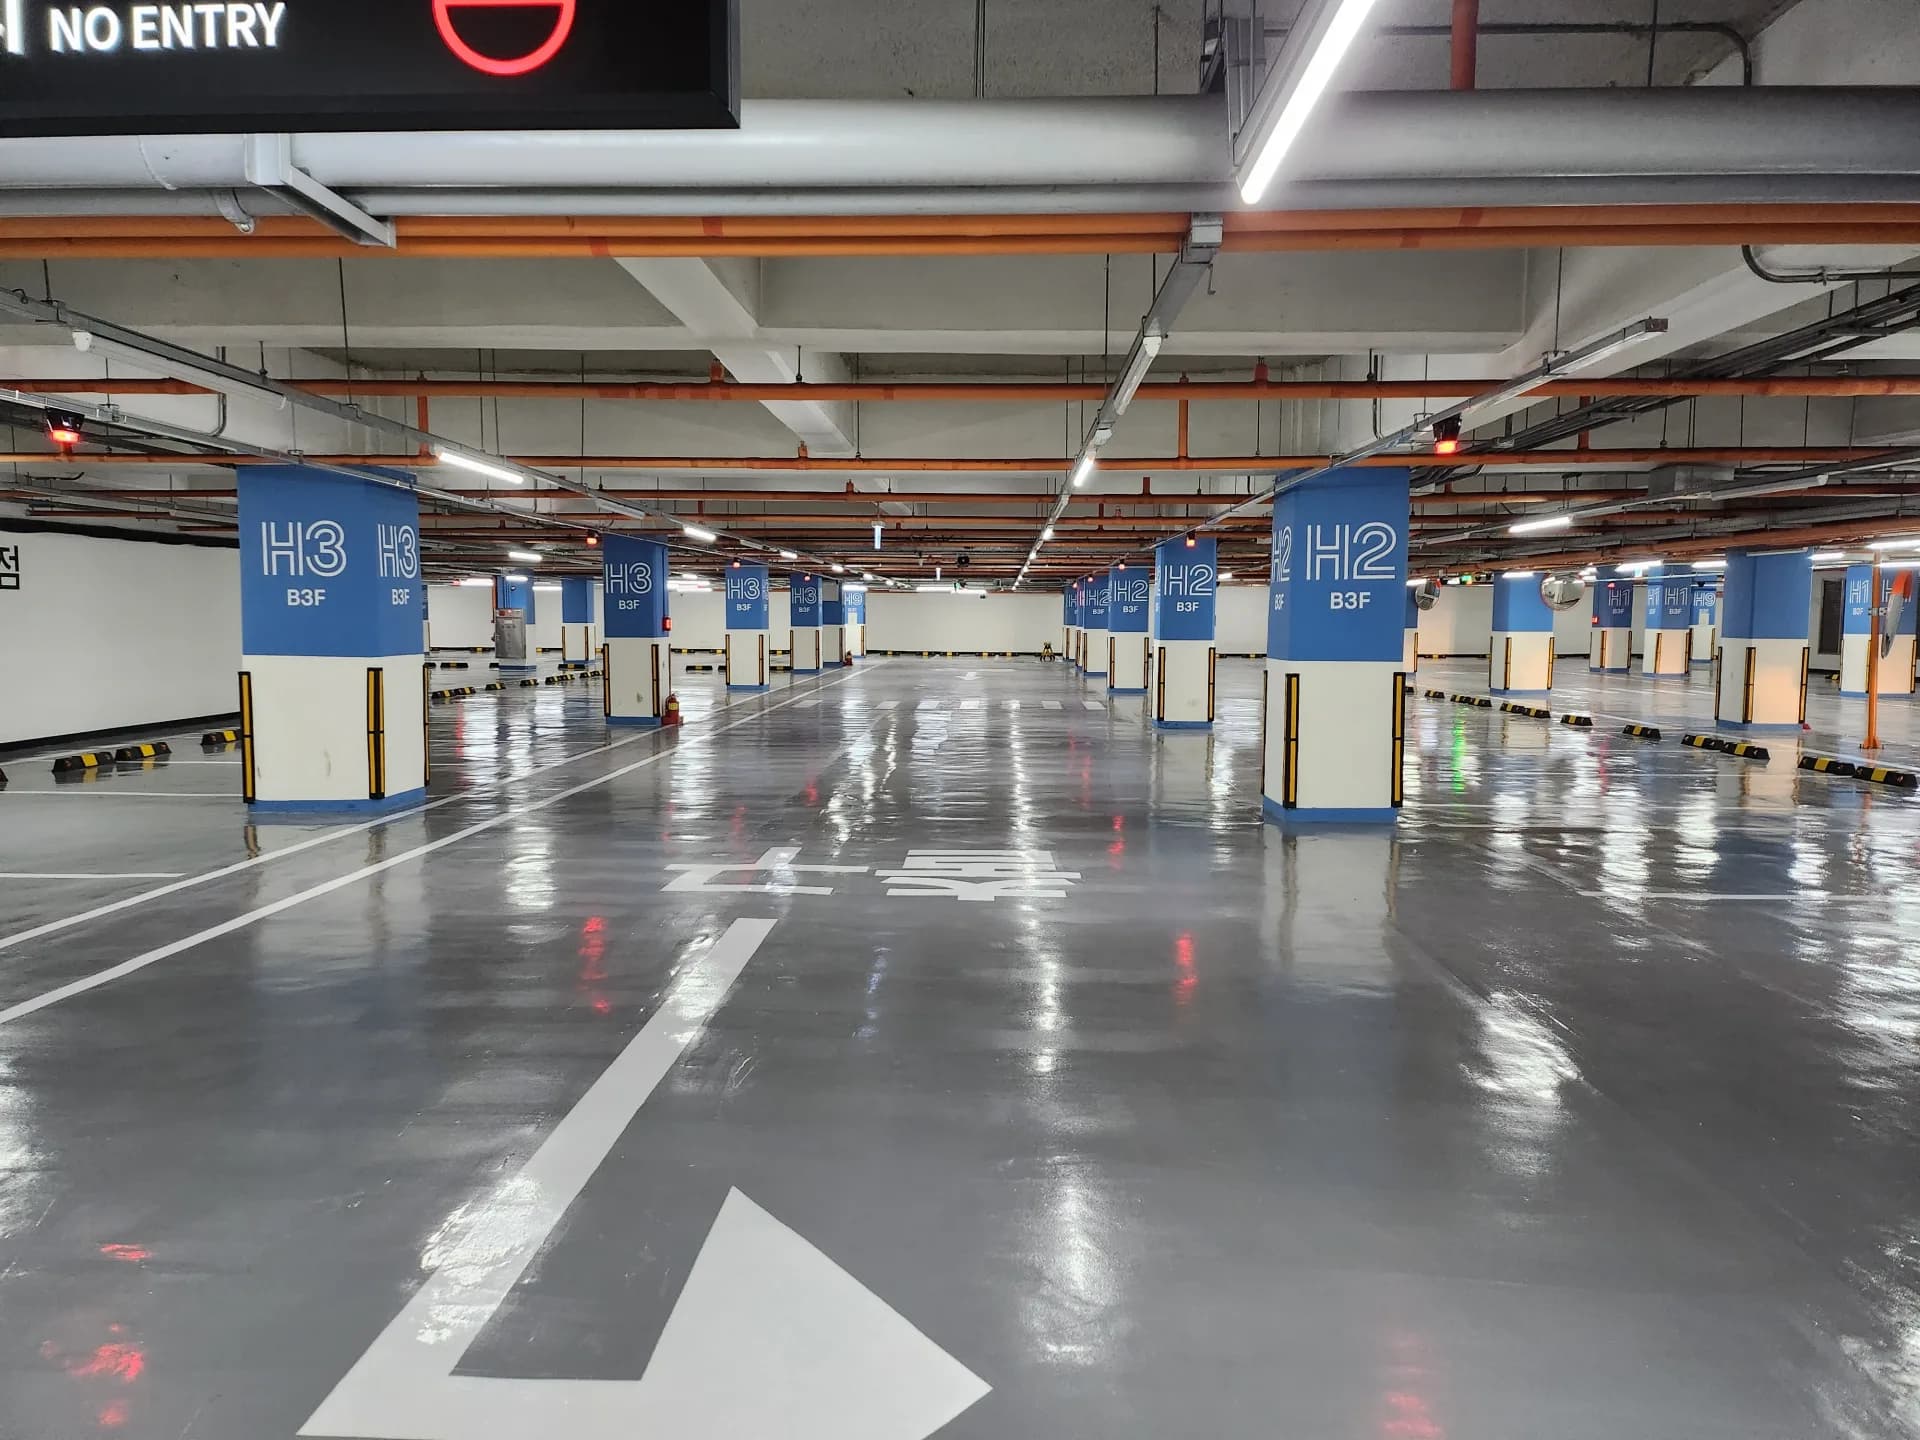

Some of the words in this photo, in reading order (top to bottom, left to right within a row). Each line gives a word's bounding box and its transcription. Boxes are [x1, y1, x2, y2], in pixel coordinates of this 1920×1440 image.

[50, 7, 121, 51] NO
[132, 2, 286, 49] ENTRY
[261, 520, 347, 577] H3
[377, 523, 418, 579] H3
[1271, 526, 1292, 582] H2
[1306, 522, 1397, 580] H2
[605, 562, 653, 594] H3
[1163, 564, 1213, 596] H2
[287, 588, 326, 606] B3F
[392, 588, 410, 605] B3F
[726, 577, 760, 600] H3
[791, 586, 817, 605] H3
[1086, 588, 1111, 606] H2
[1114, 580, 1149, 602] H2
[1608, 587, 1630, 607] H1
[1664, 586, 1688, 606] H1
[1849, 579, 1870, 604] H1
[618, 600, 641, 610] B3F
[736, 603, 752, 611] B3F
[1122, 605, 1139, 613] B3F
[1176, 601, 1200, 612] B3F
[1330, 591, 1371, 609] B3F
[1693, 592, 1716, 607] H9
